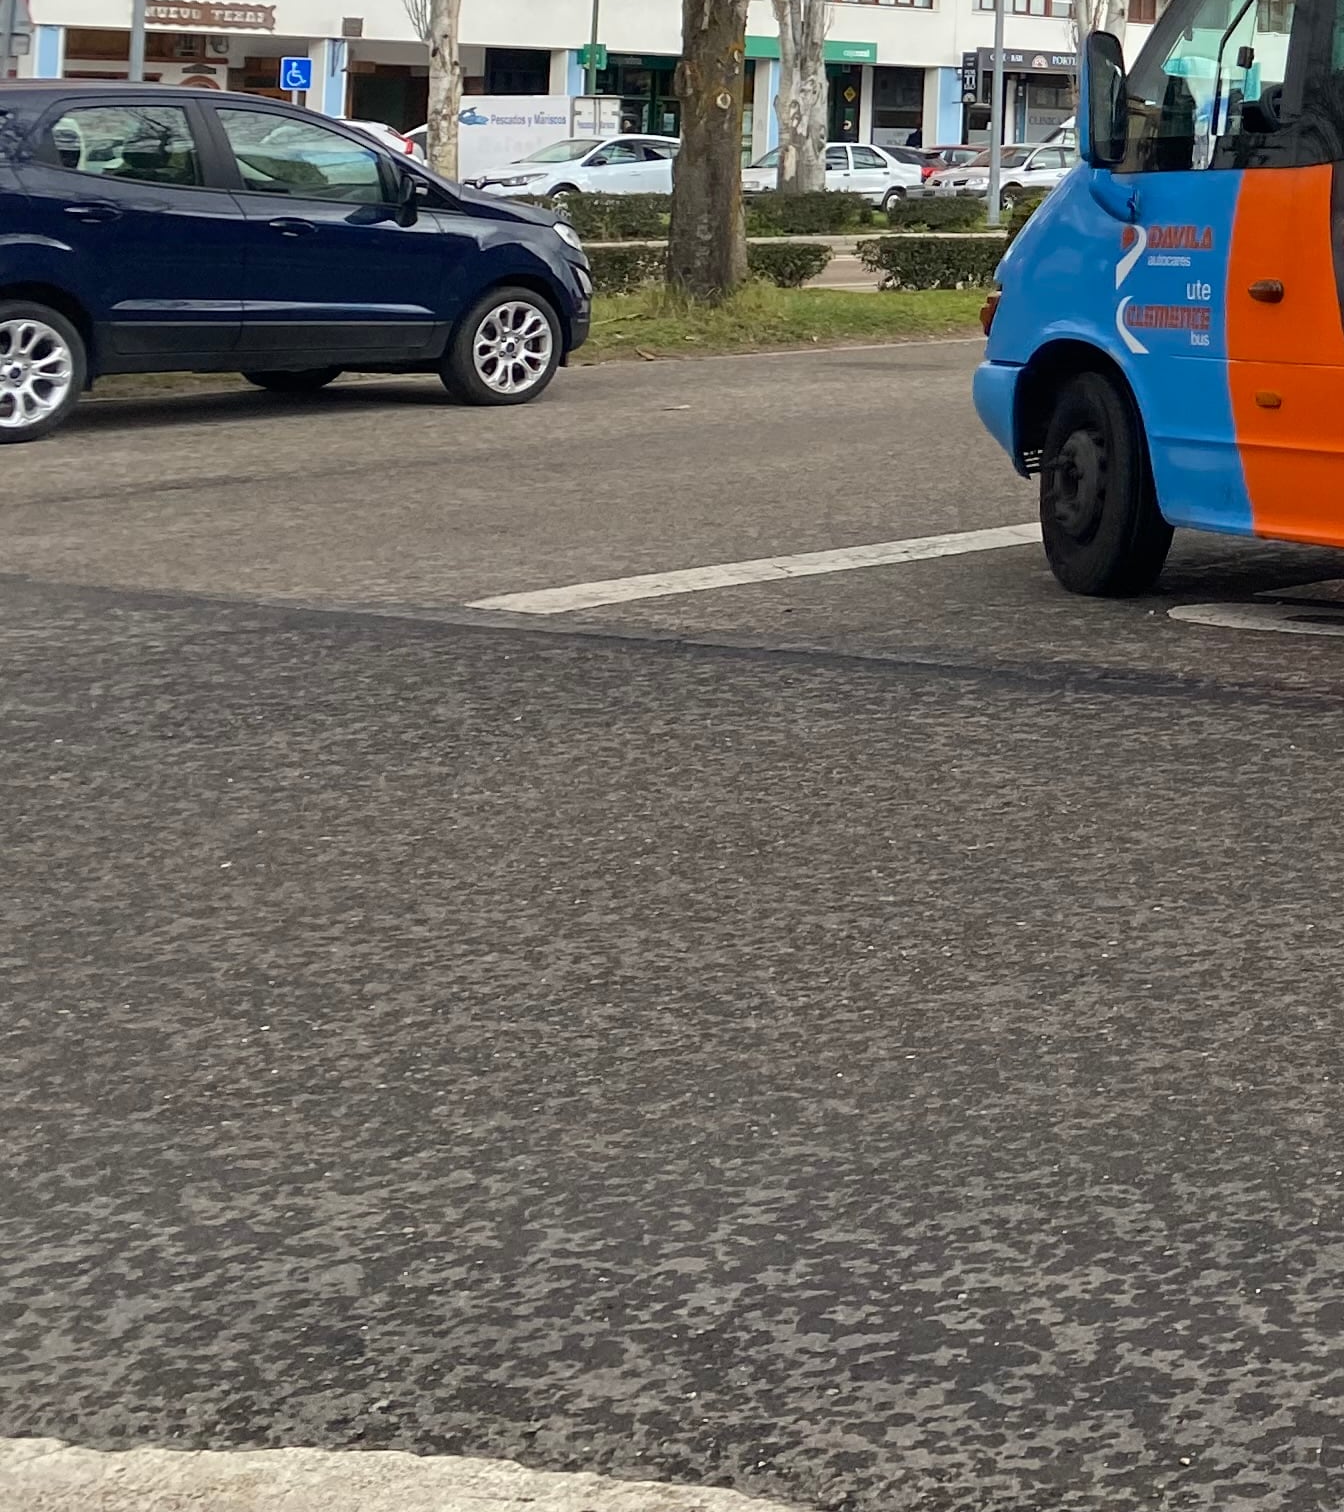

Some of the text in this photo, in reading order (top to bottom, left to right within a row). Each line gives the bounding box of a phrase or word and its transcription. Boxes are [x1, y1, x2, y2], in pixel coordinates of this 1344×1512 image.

[491, 114, 526, 125] Pescados
[534, 114, 567, 125] Mariscos
[1147, 255, 1191, 266] autocares
[1186, 279, 1211, 301] ute
[1190, 330, 1210, 345] bus
